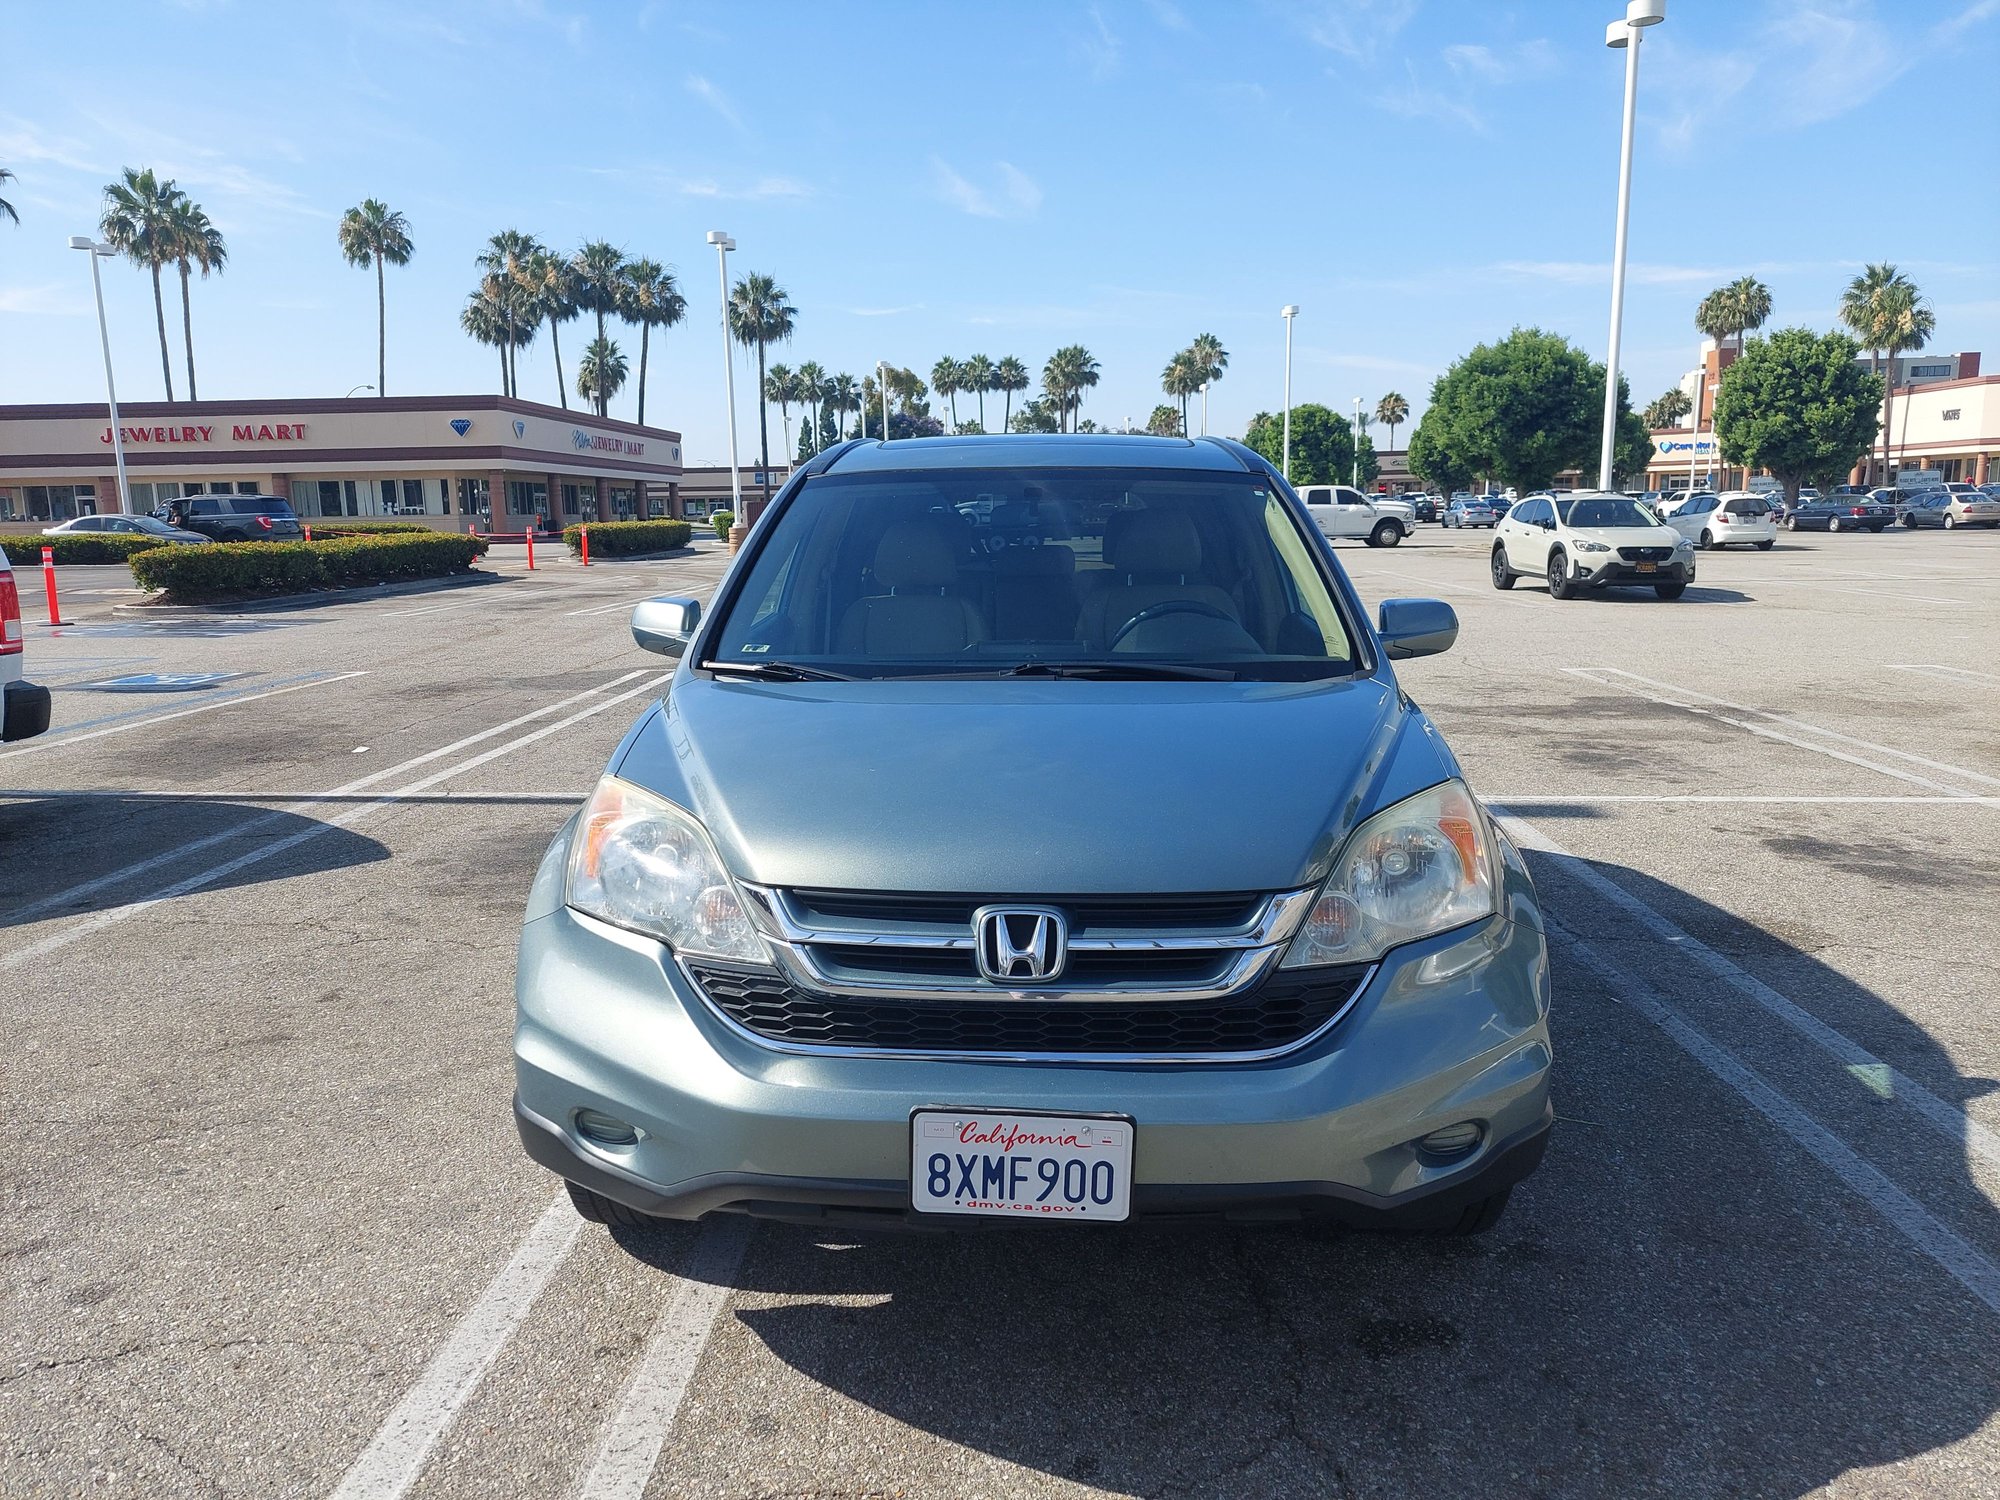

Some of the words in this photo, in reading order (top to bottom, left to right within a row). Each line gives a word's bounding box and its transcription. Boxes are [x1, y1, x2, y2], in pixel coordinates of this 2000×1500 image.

[1942, 409, 1962, 421] VANS
[100, 425, 214, 444] JEWELRY
[232, 423, 307, 441] MART
[592, 435, 624, 453] JEWELRY
[627, 441, 645, 456] MART
[959, 1121, 1092, 1152] California
[927, 1153, 1115, 1206] 8XMF900
[966, 1200, 1076, 1213] dmv.ca.gov
